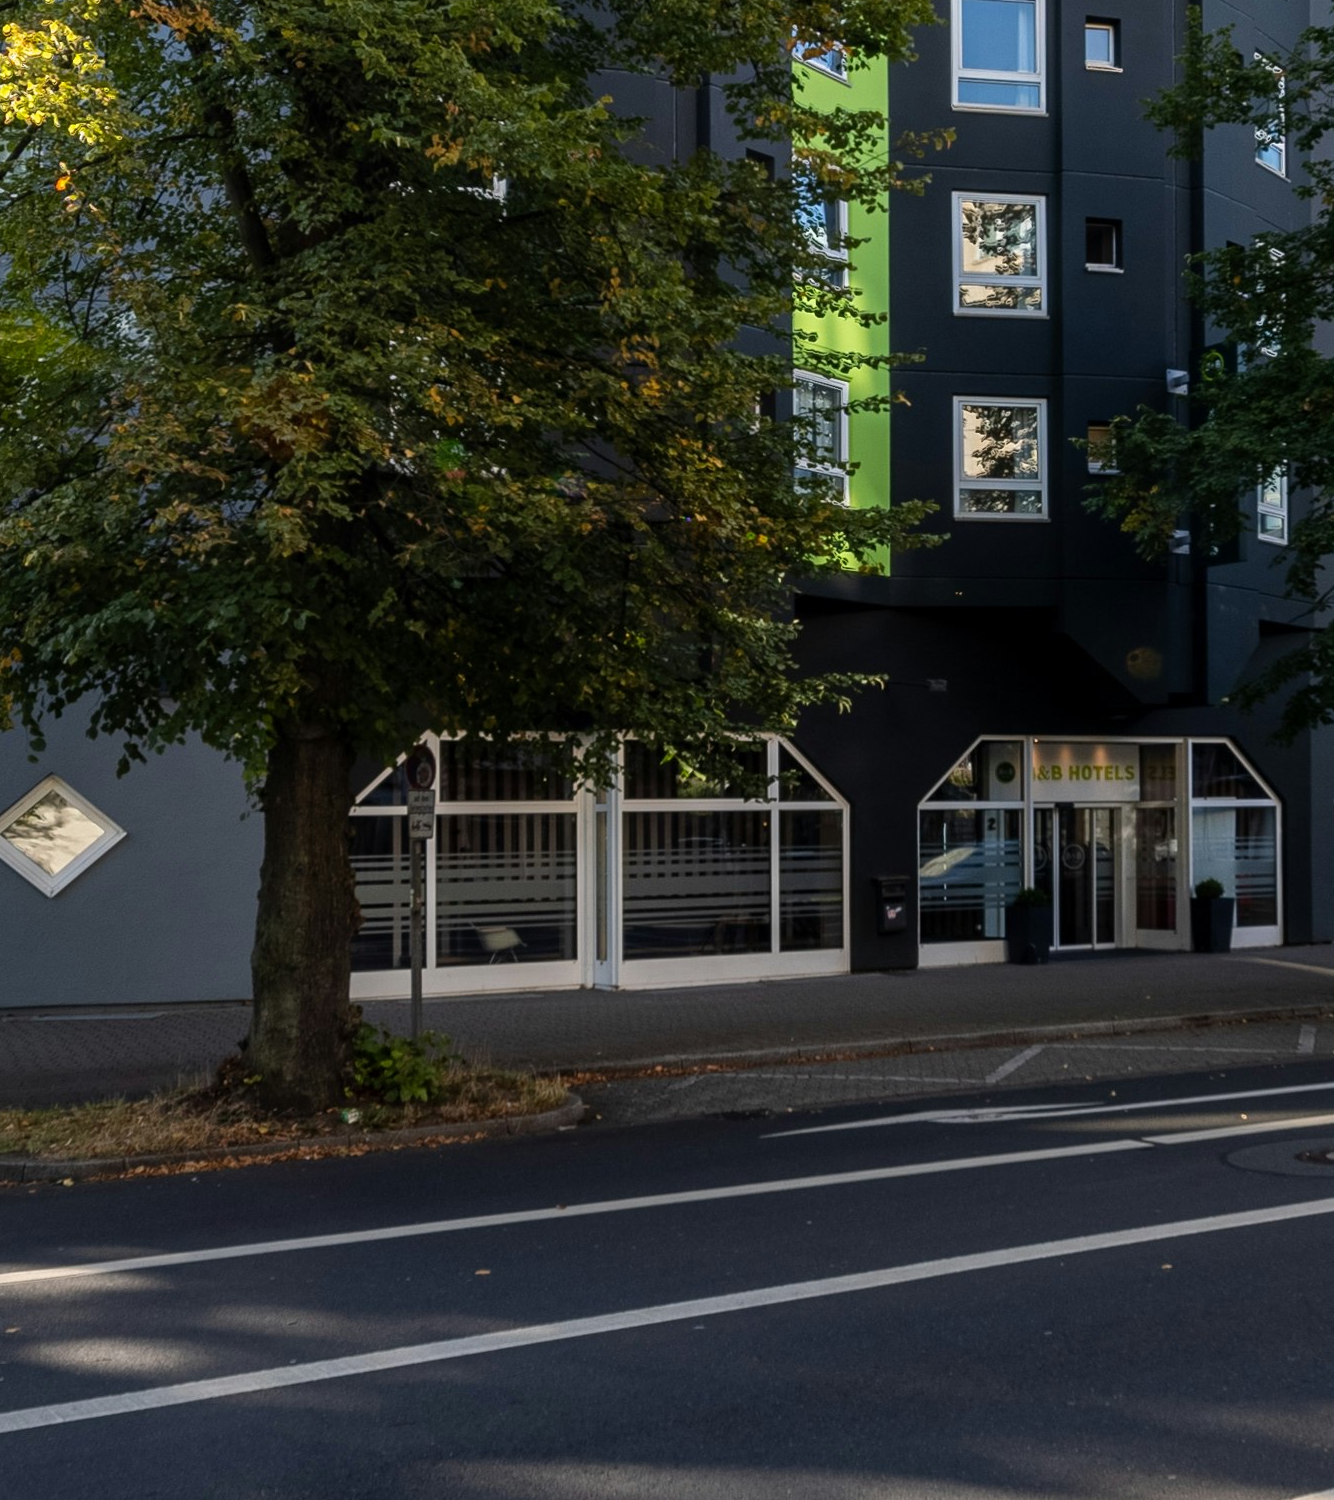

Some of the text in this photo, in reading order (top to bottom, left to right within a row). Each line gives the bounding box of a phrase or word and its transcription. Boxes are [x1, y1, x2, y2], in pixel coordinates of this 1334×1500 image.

[1032, 764, 1063, 781] &B
[1068, 764, 1135, 781] HOTELS
[987, 817, 996, 831] 2
